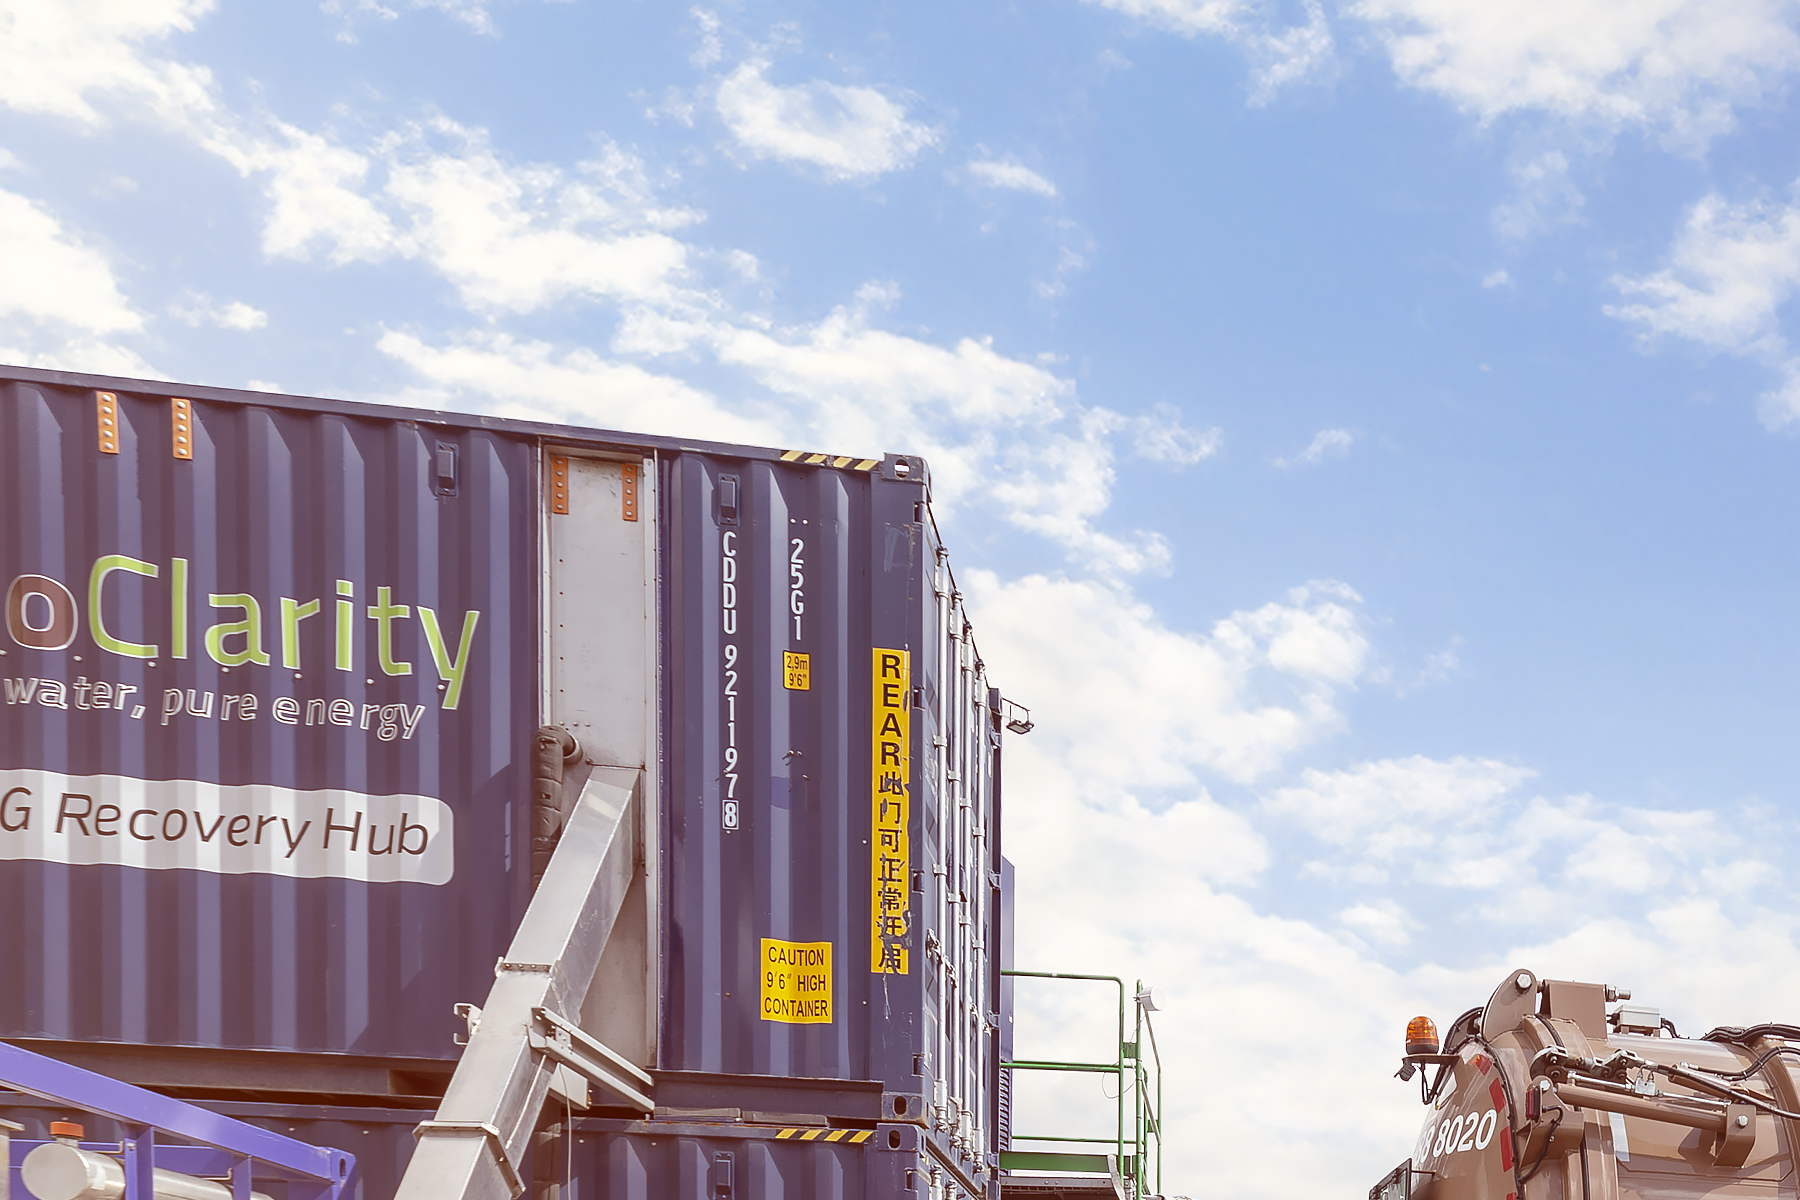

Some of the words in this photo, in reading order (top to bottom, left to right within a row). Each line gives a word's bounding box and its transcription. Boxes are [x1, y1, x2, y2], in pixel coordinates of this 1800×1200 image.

[722, 530, 738, 635] CDDU
[790, 537, 805, 641] 25G1
[4, 553, 481, 711] oClarity
[3, 675, 147, 719] water,
[161, 687, 259, 726] pure
[271, 695, 426, 742] energy
[879, 652, 902, 767] REAR
[54, 791, 313, 859] Recovery
[322, 806, 430, 856] Hub
[768, 946, 824, 967] CAUTION
[797, 973, 826, 992] HIGH
[763, 996, 829, 1018] CONTAINER
[1432, 1108, 1498, 1158] 8020
